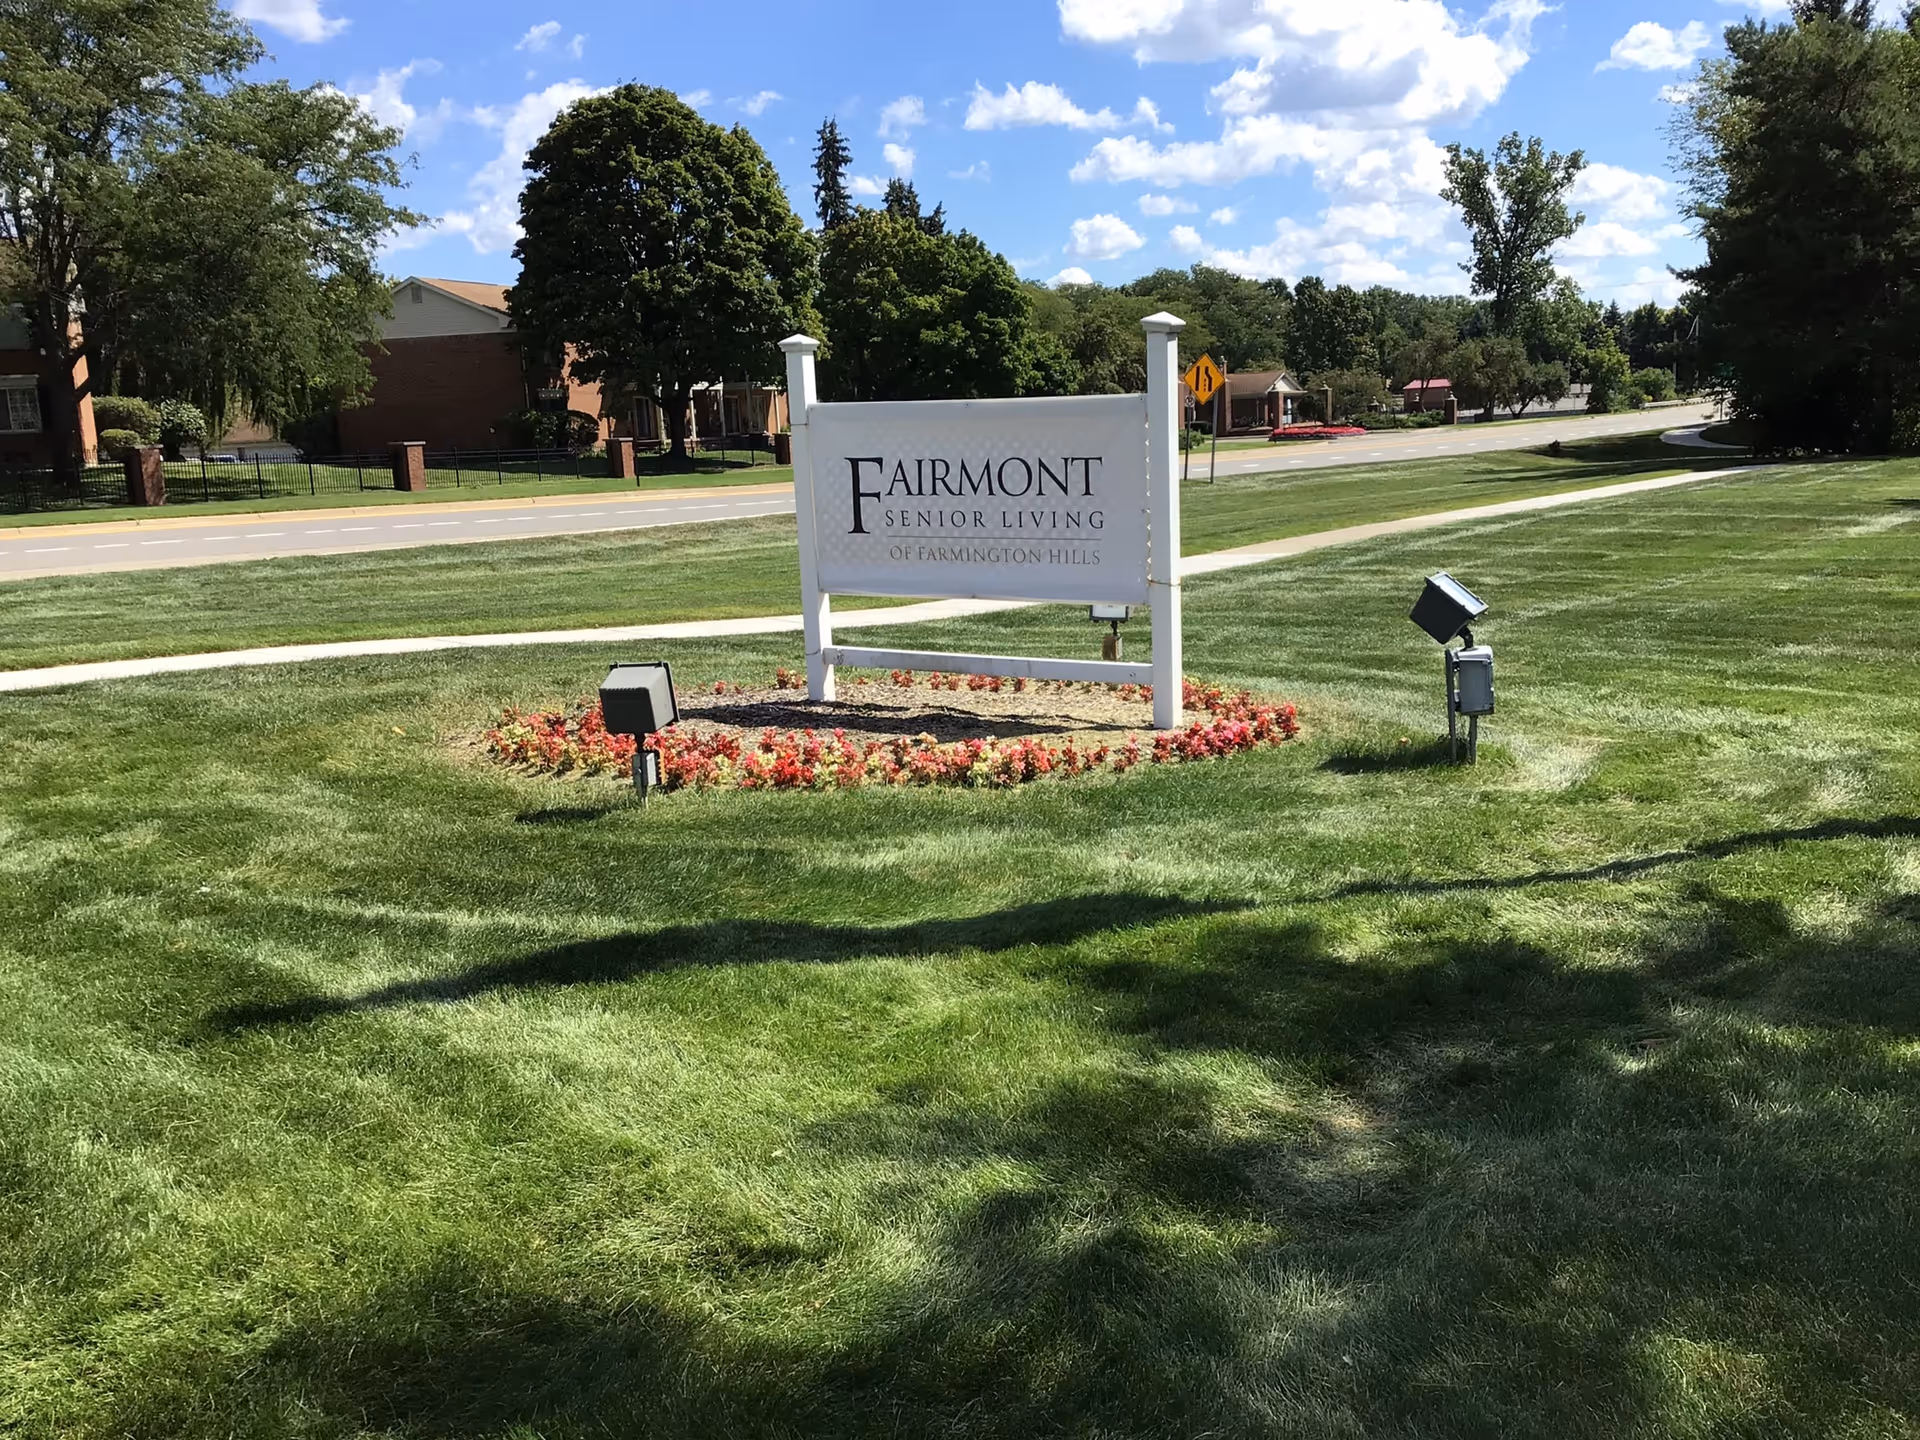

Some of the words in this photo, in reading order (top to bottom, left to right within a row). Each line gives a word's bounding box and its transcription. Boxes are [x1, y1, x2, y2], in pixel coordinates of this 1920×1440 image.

[844, 456, 1103, 534] FAIRMONT
[885, 510, 986, 528] SENIOR
[1001, 511, 1105, 530] LIVING
[889, 545, 912, 560] OF
[918, 546, 1042, 564] FARMINGTON
[1049, 548, 1101, 566] HILLS
